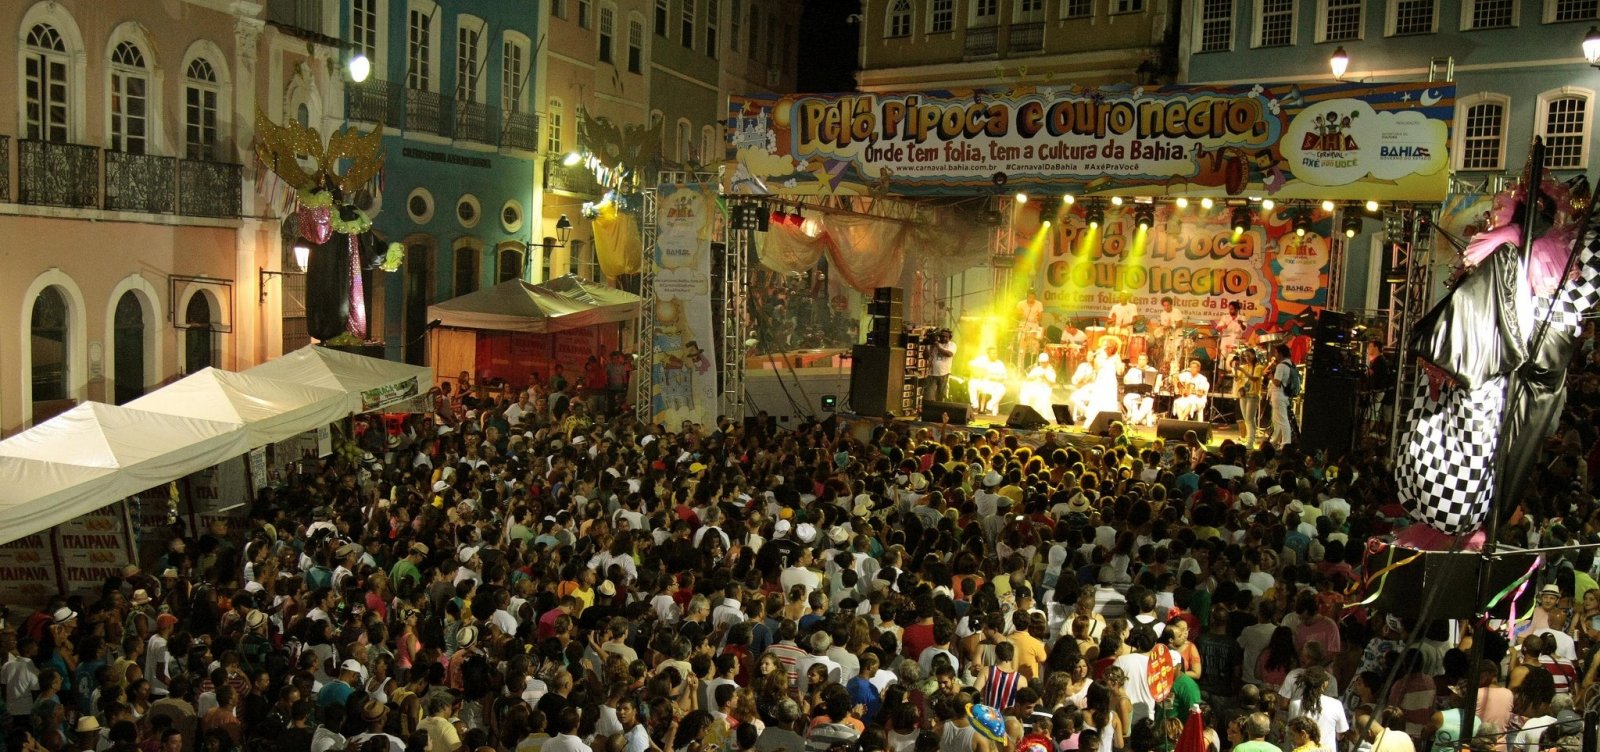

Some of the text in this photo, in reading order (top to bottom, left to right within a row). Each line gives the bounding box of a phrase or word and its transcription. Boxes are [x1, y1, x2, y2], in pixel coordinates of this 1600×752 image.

[801, 96, 878, 145] Pelô,
[1017, 101, 1043, 138] e
[1046, 100, 1135, 138] ouro
[1137, 100, 1266, 139] negro.
[1301, 132, 1359, 151] BAHIA
[865, 144, 903, 162] Onde
[907, 142, 938, 162] tem
[944, 141, 985, 163] folia,
[988, 140, 1020, 162] tem
[1023, 144, 1033, 159] a
[1101, 139, 1124, 159] da
[1130, 140, 1187, 160] Bahia.
[1380, 146, 1424, 157] BAHIA
[896, 163, 997, 171] www.carnaval.bahia.com.br
[1006, 163, 1077, 171] #CarnavalDaBahia
[1202, 297, 1217, 308] da
[63, 534, 120, 548] ITAIPAVA
